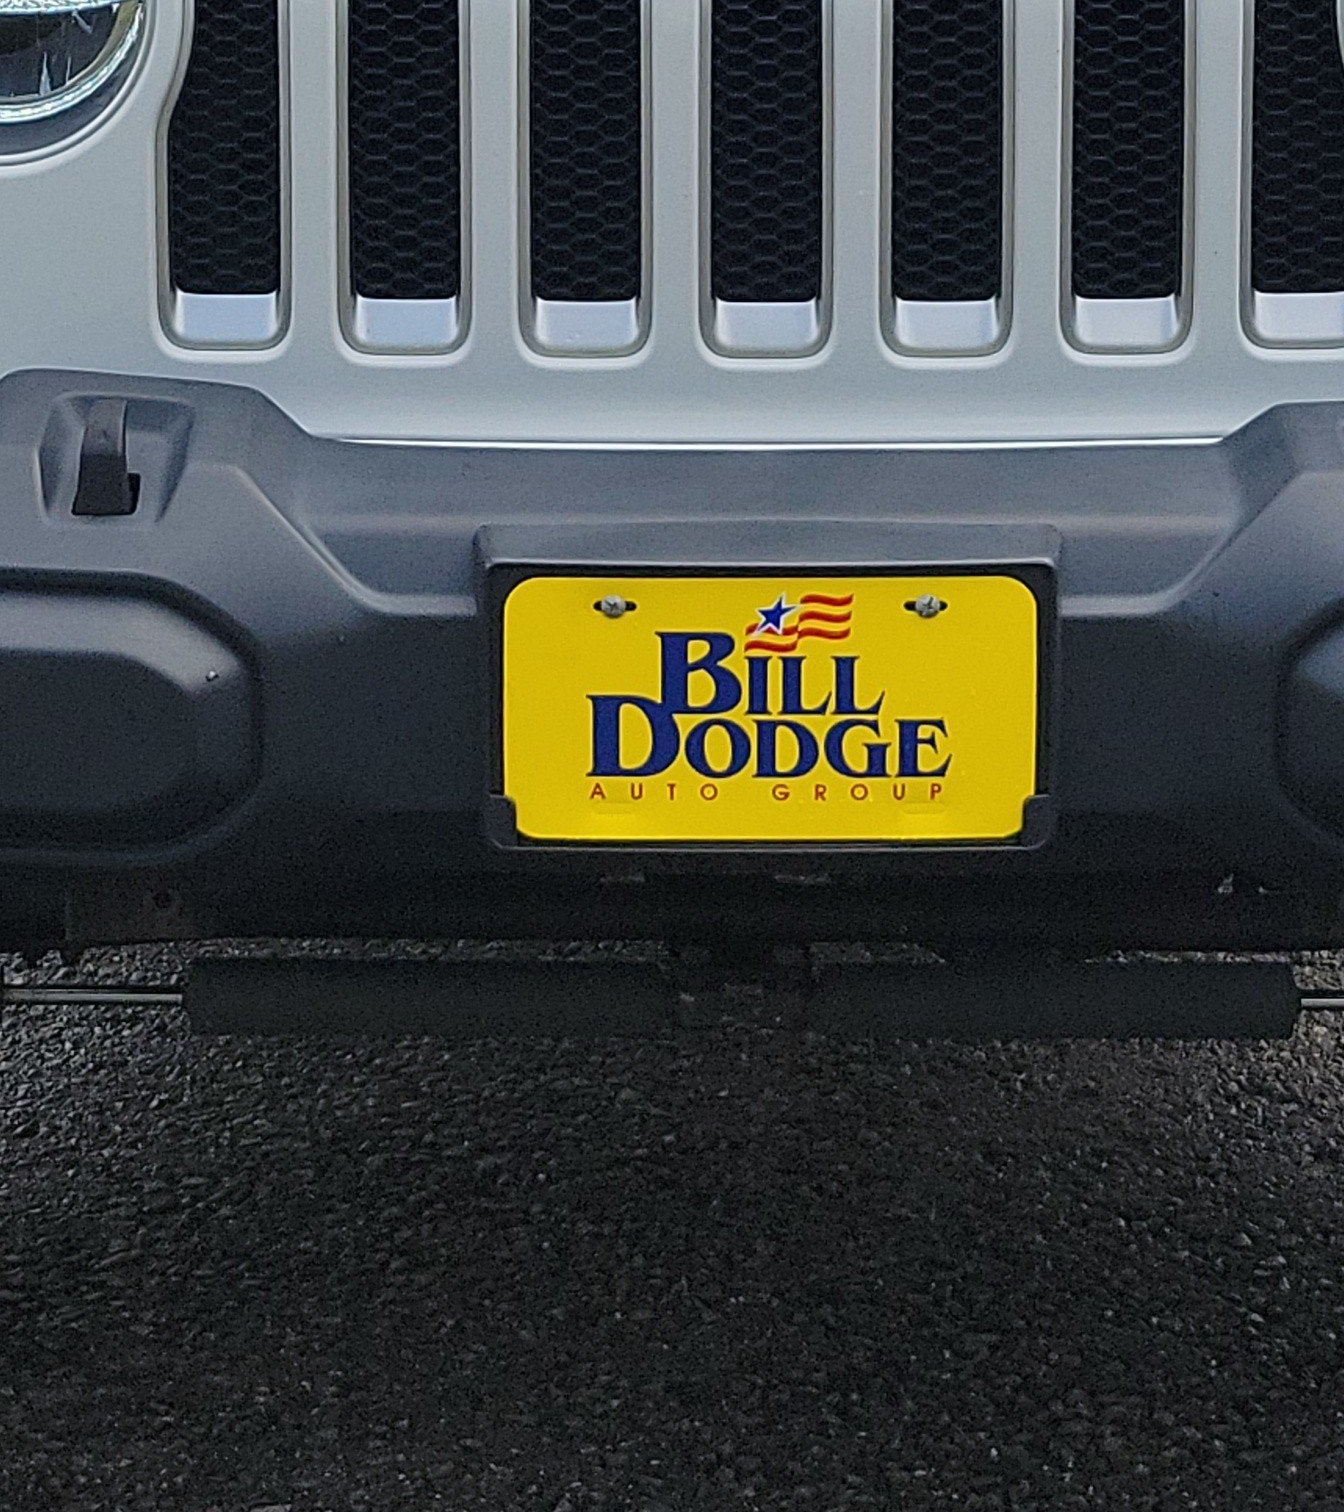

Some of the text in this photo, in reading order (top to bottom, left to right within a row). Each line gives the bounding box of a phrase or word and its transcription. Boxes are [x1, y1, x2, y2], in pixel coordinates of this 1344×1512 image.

[656, 631, 885, 715] BILL
[586, 694, 953, 778] DODGE
[590, 782, 943, 801] AUTO GROUP
